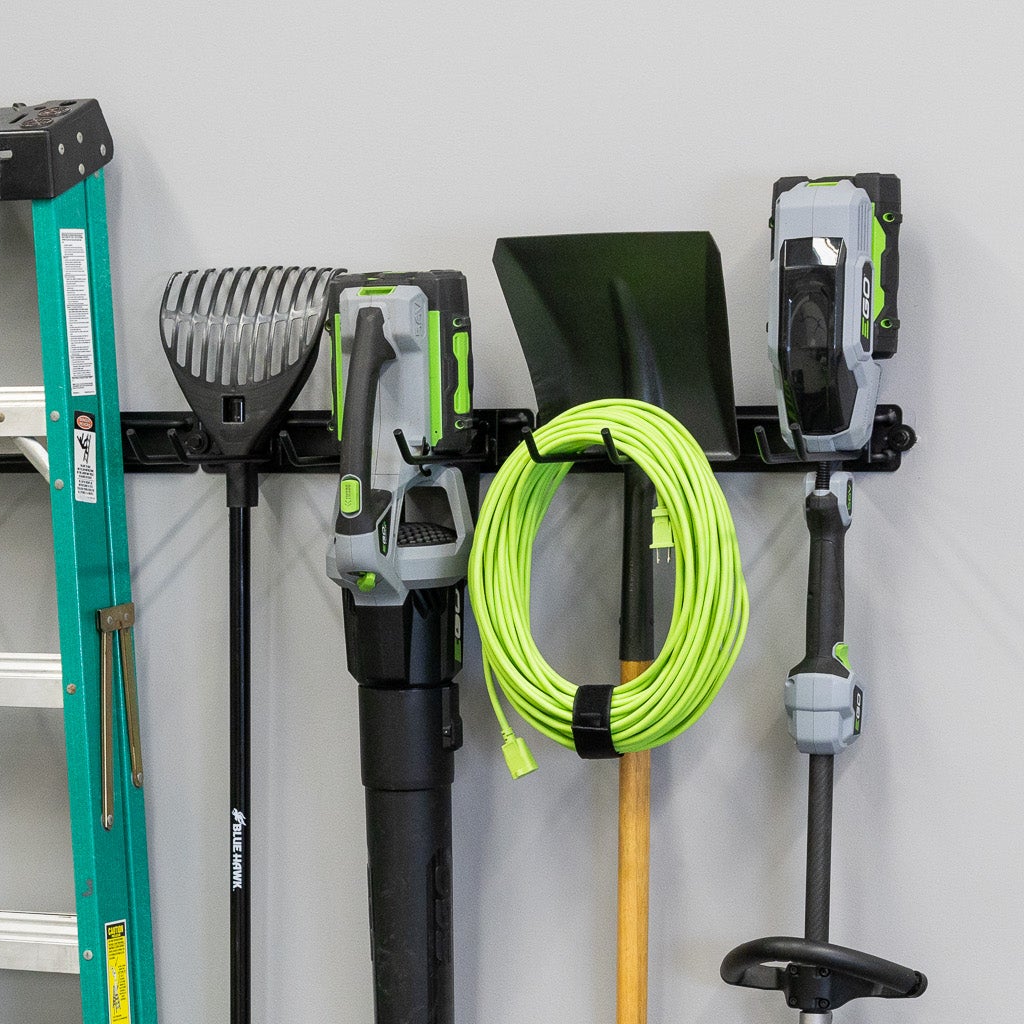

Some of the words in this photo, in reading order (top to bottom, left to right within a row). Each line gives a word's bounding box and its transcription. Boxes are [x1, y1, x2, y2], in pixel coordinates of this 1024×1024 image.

[861, 276, 871, 340] EGO
[232, 824, 243, 853] BLUE
[232, 853, 243, 889] HAWK
